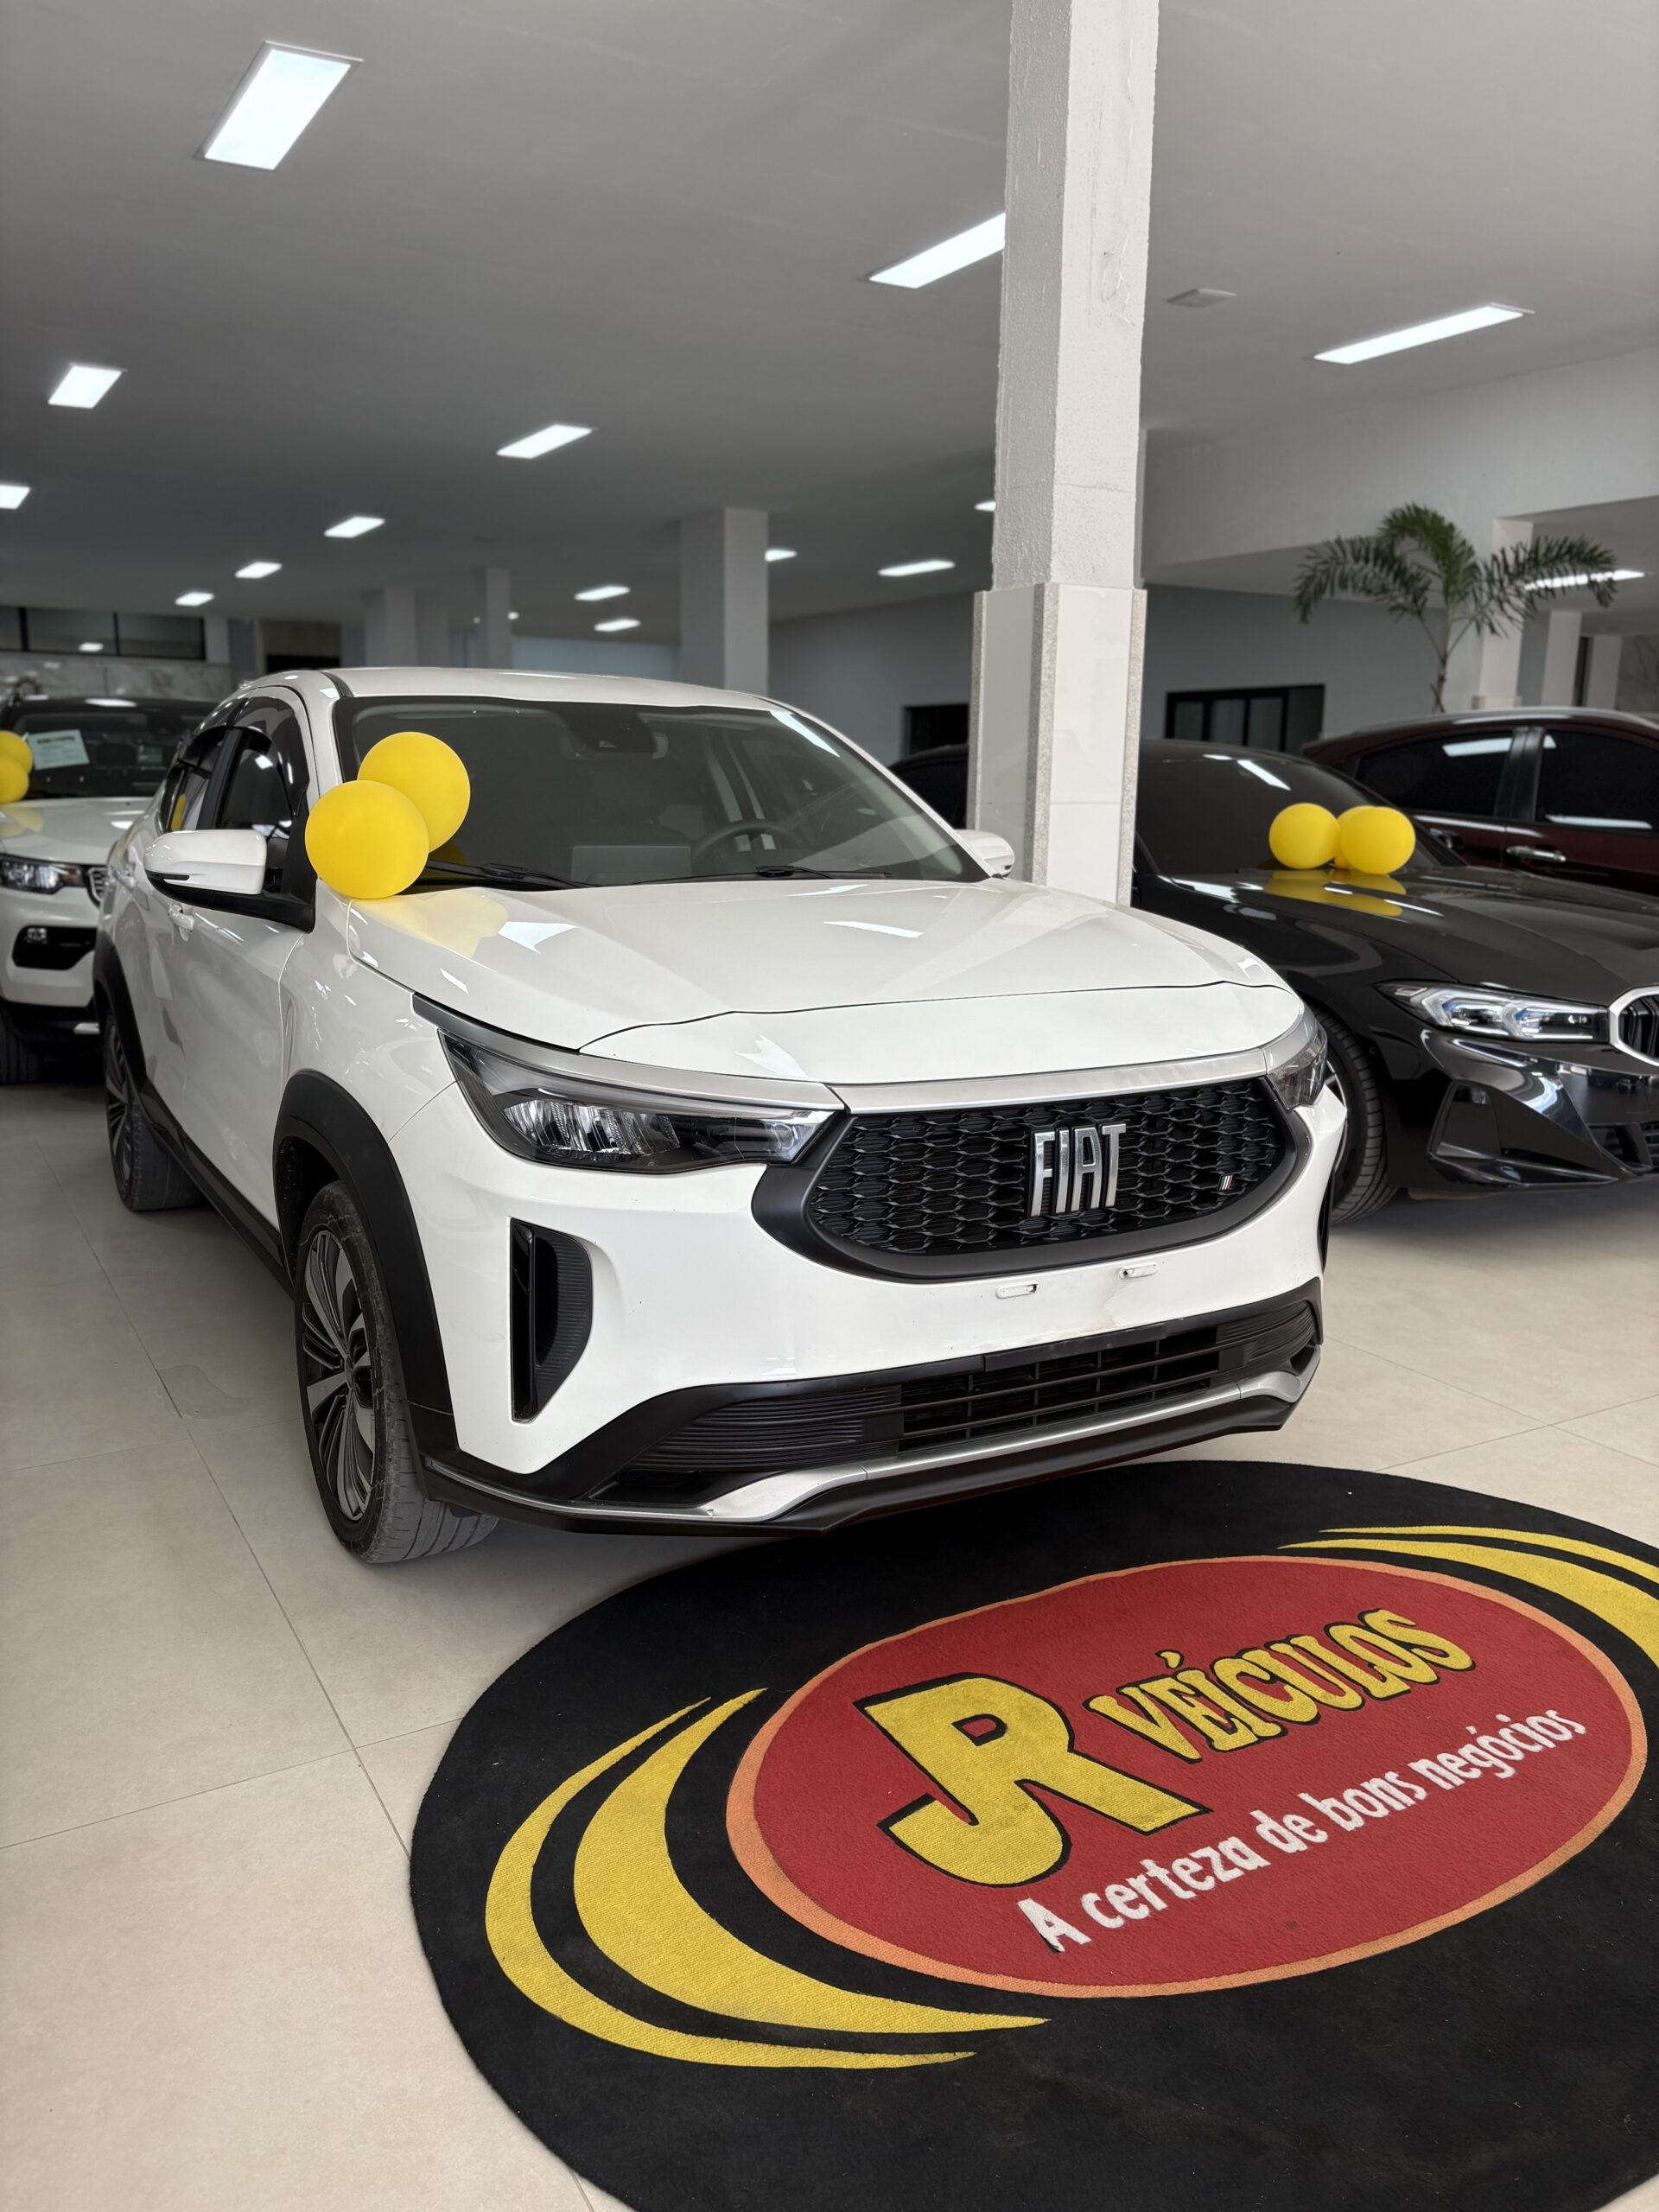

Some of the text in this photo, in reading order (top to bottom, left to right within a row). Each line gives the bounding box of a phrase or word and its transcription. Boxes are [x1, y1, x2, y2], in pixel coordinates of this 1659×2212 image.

[1030, 1122, 1127, 1217] FIAT
[1083, 1608, 1476, 1764] VEÍCULOS
[1018, 1708, 1587, 1952] A certeza de bons negócios
